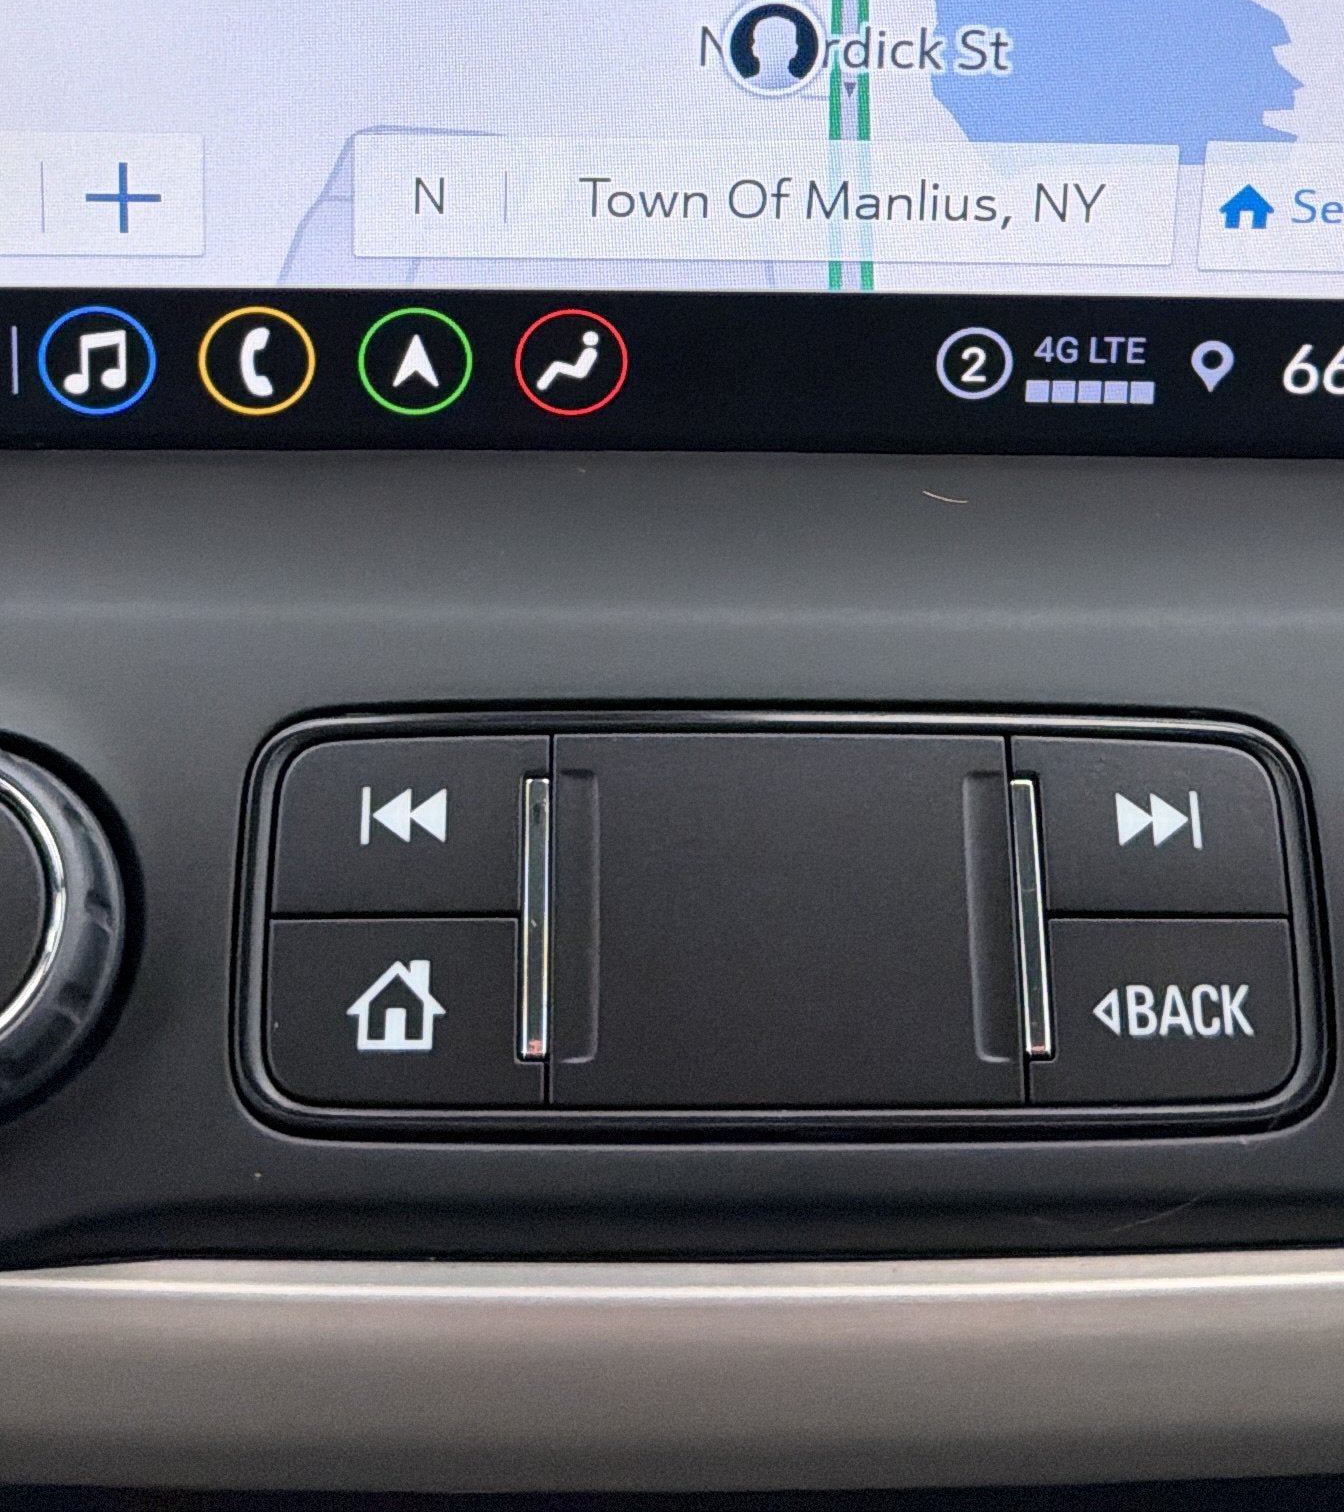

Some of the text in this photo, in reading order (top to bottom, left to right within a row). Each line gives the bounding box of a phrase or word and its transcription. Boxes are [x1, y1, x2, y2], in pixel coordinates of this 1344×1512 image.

[959, 28, 1010, 71] St
[413, 176, 447, 215] N
[579, 176, 1107, 231] Town Of Manlius, NY
[960, 347, 987, 384] 2
[1033, 336, 1147, 366] 4G LTE
[1125, 984, 1255, 1038] BACK
